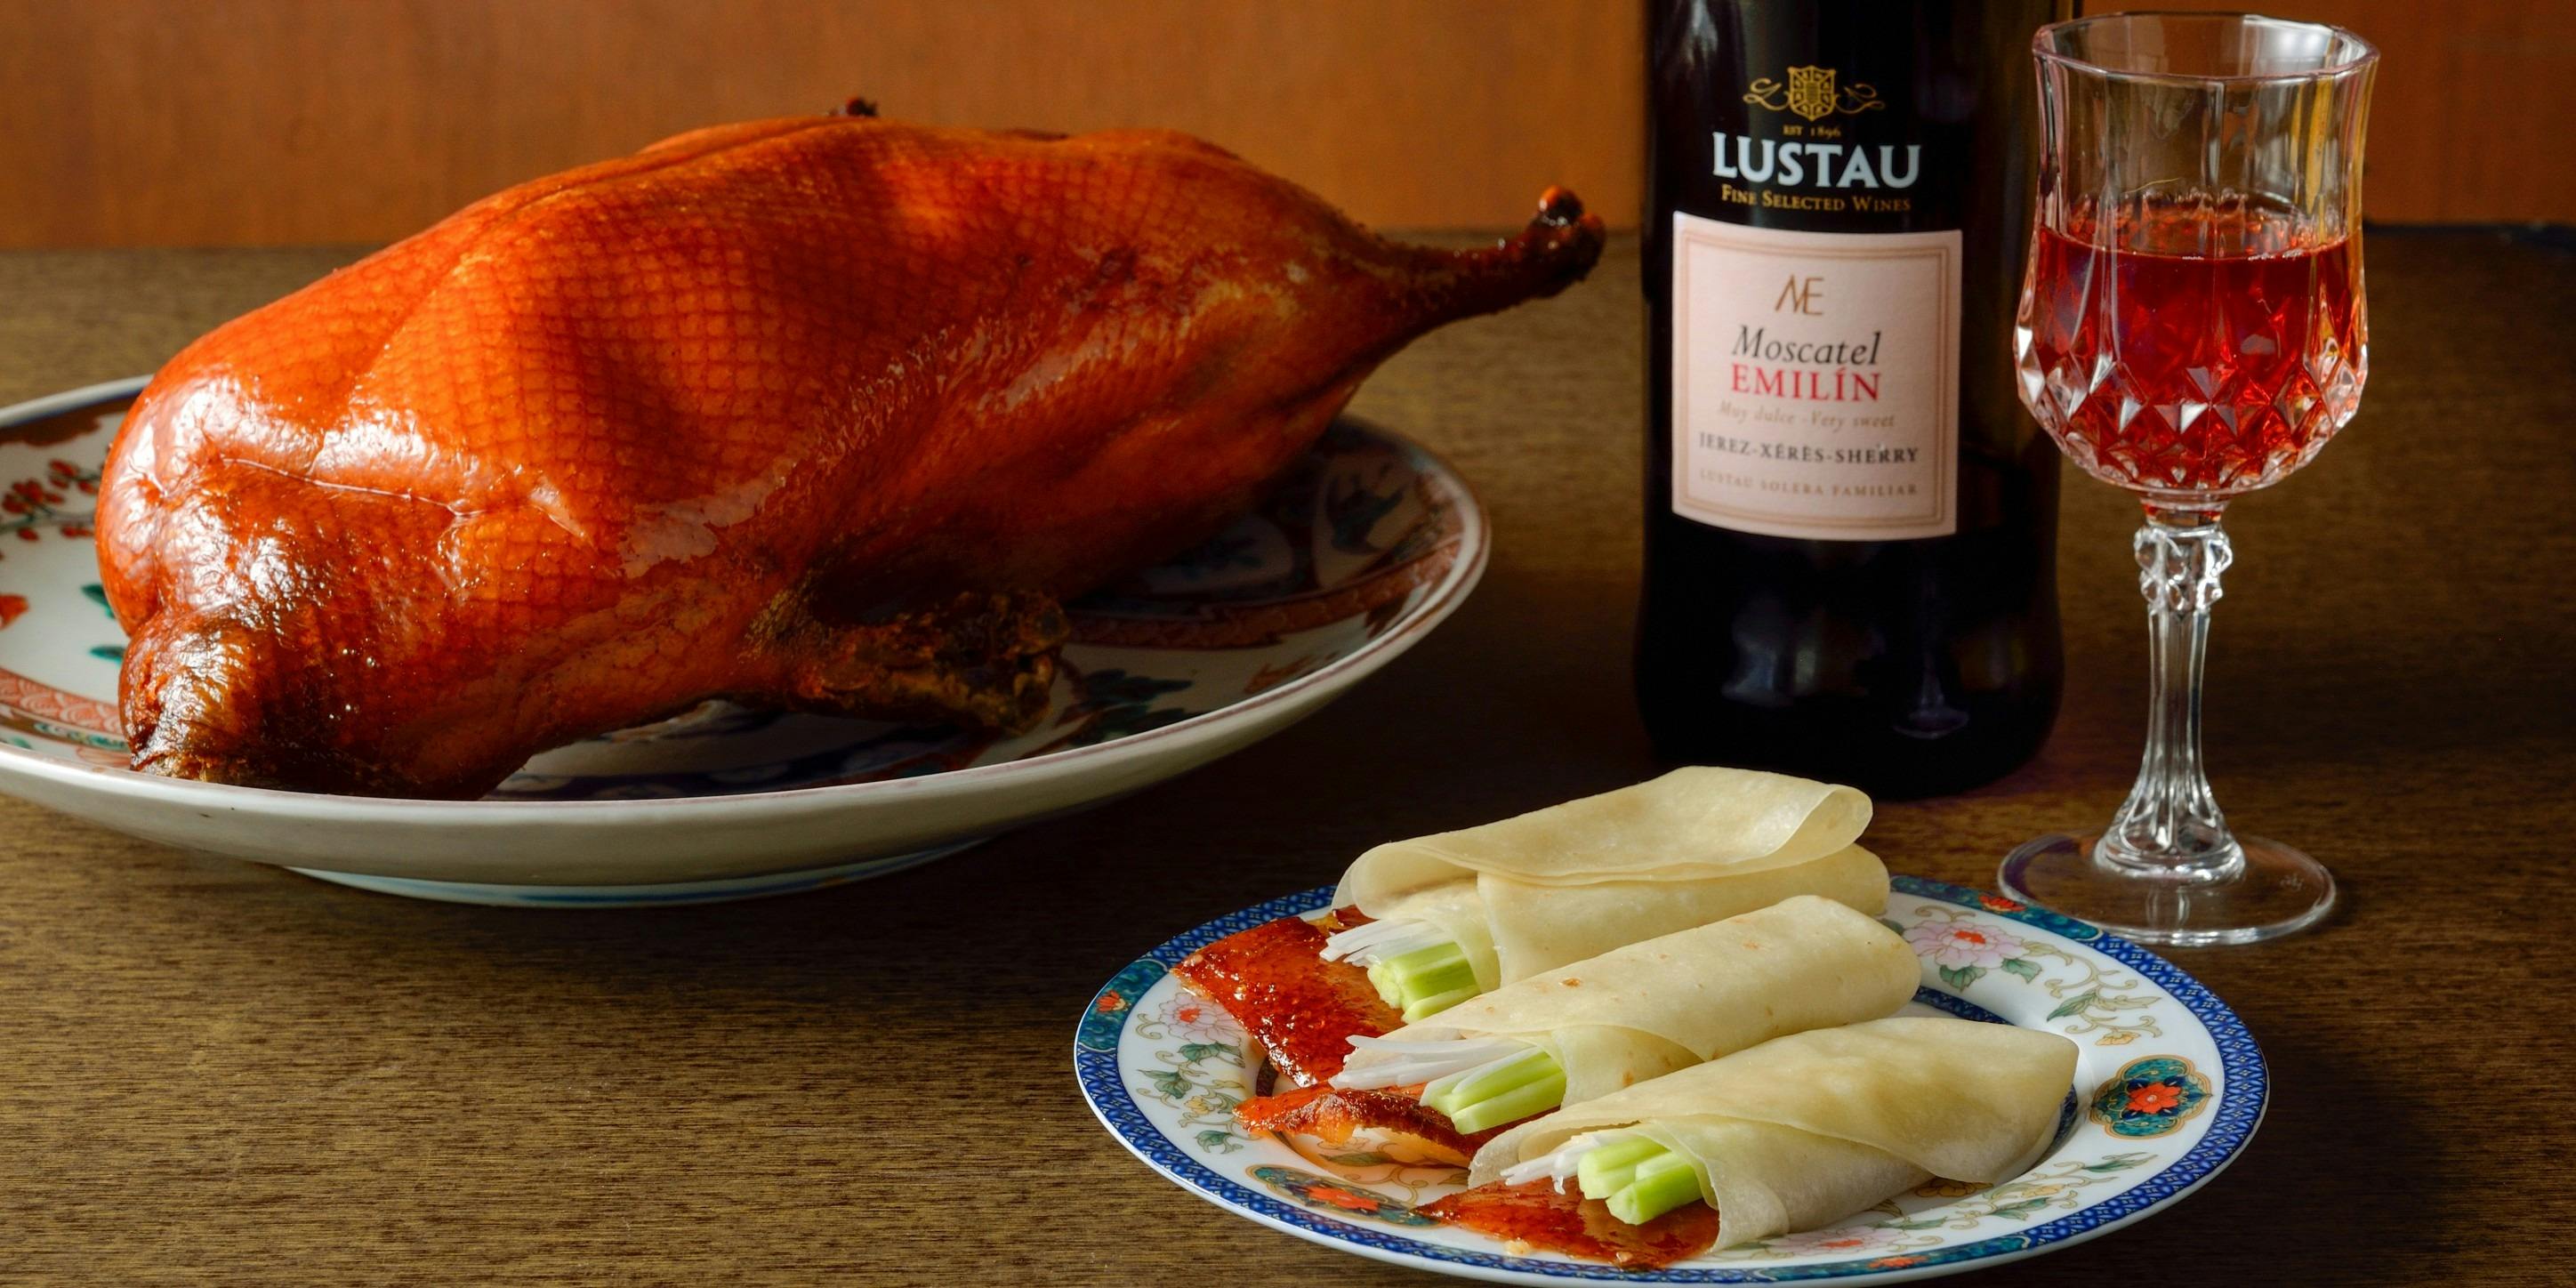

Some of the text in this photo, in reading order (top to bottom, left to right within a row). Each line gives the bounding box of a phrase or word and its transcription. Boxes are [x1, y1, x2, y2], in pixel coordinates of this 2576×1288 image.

[1810, 125, 1841, 139] 1896
[1712, 132, 1921, 189] LUSTAU
[1732, 325, 1882, 366] Moscatel
[1731, 363, 1881, 401] EMILÍN
[1719, 399, 1749, 424] Muy
[1754, 406, 1795, 425] dulce
[1811, 410, 1844, 433] Very
[1852, 414, 1896, 428] sweet
[1760, 479, 1824, 496] SOLERA
[1832, 483, 1918, 497] FAMILIAR
